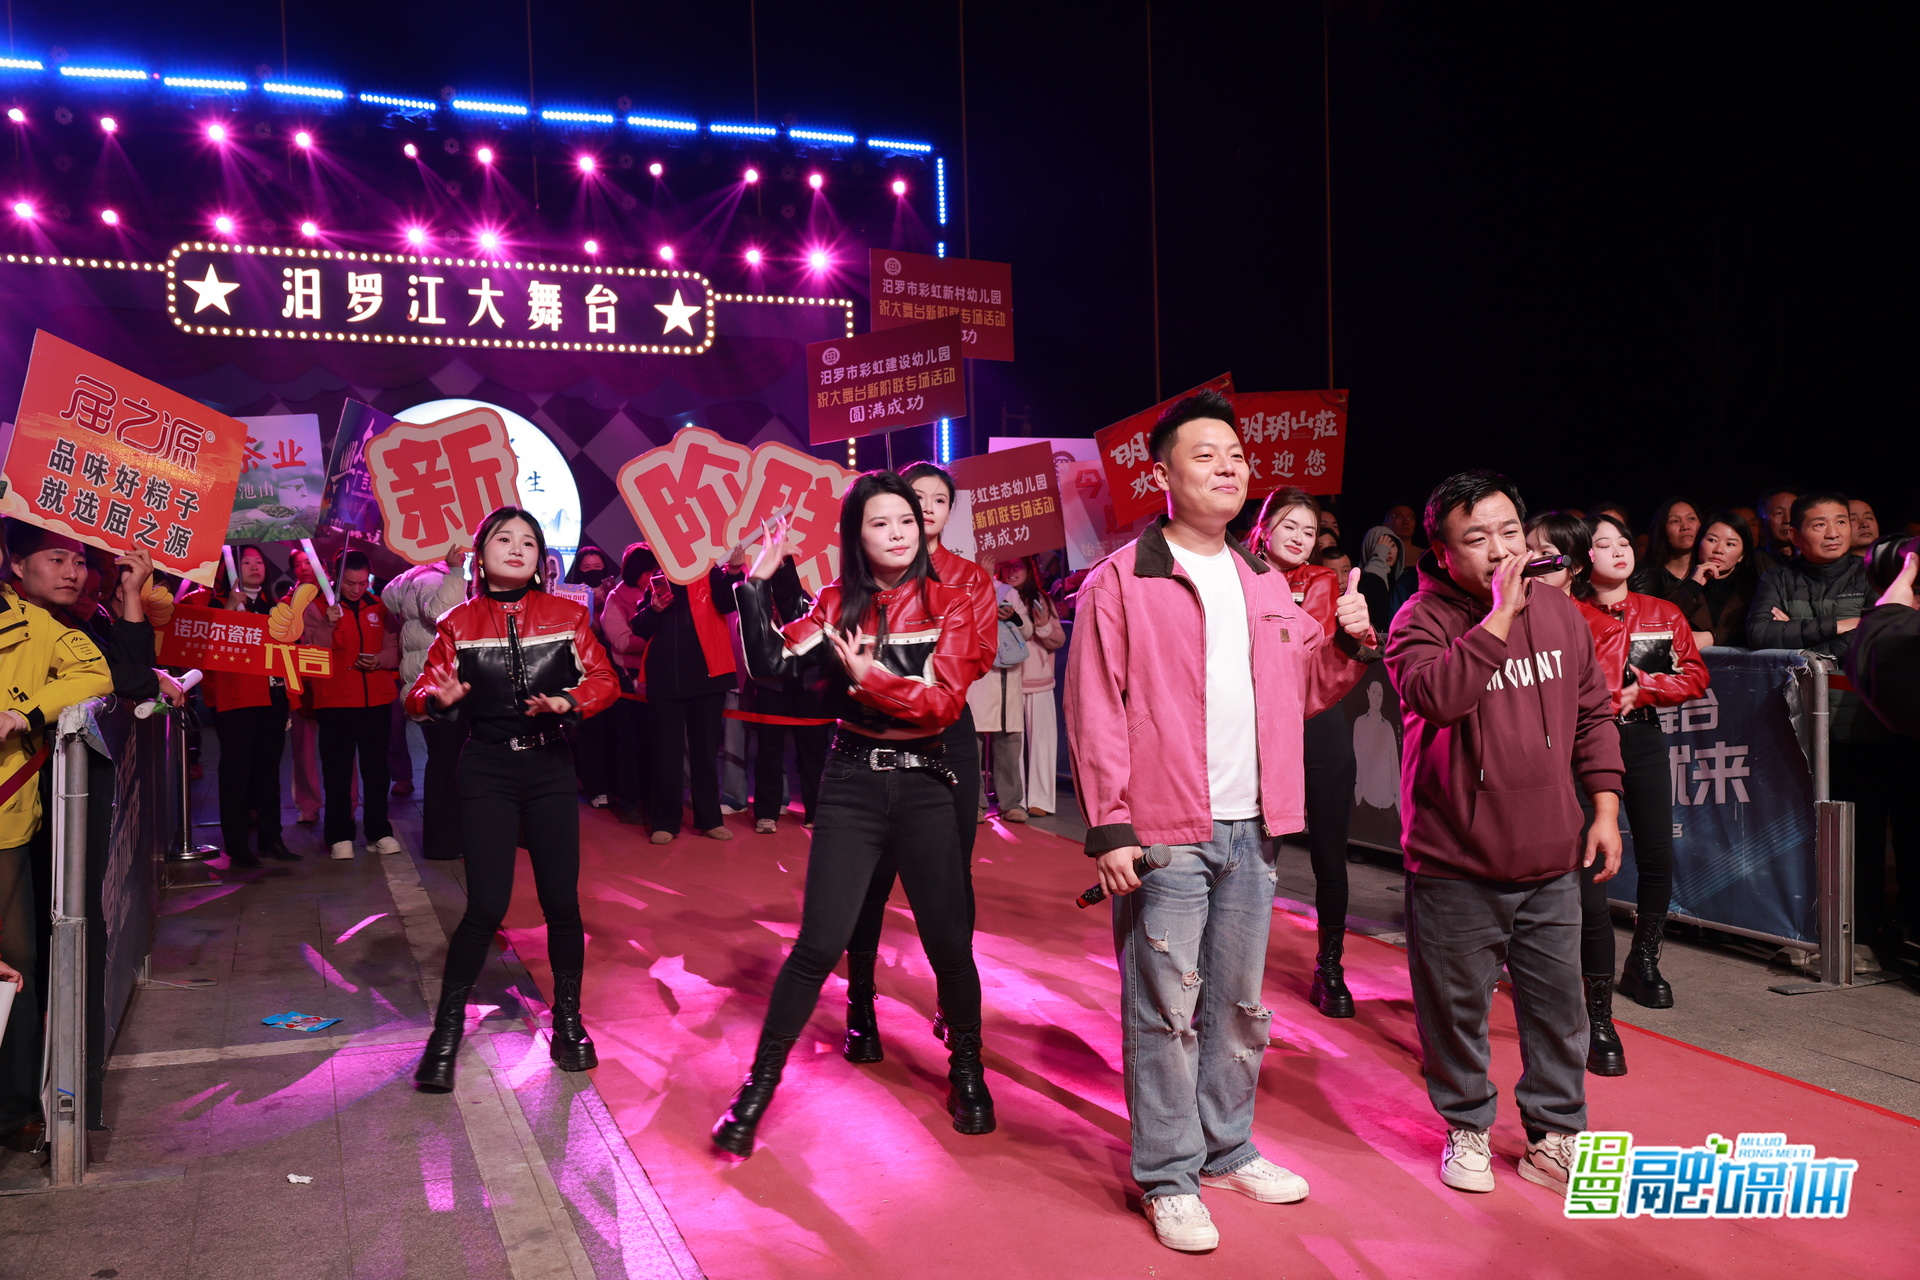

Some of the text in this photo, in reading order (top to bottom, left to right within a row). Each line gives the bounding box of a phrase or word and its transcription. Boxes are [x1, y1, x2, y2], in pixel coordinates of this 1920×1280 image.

[282, 267, 618, 334] 汨罗江大舞台
[881, 278, 1002, 305] 汨罗市彩虹新村幼儿园
[816, 366, 956, 409] 祝大舞台新阶联专场活动
[820, 345, 951, 386] 汨罗市彩虹建设幼儿园
[60, 373, 205, 474] 屈之源
[849, 395, 924, 424] 圆满成功
[47, 437, 200, 520] 品味好粽子
[382, 423, 504, 549] 新
[35, 476, 193, 559] 就选屈之源
[973, 524, 1030, 555] 满成功
[174, 618, 263, 646] 诺贝尔瓷砖
[264, 642, 331, 692] 代言
